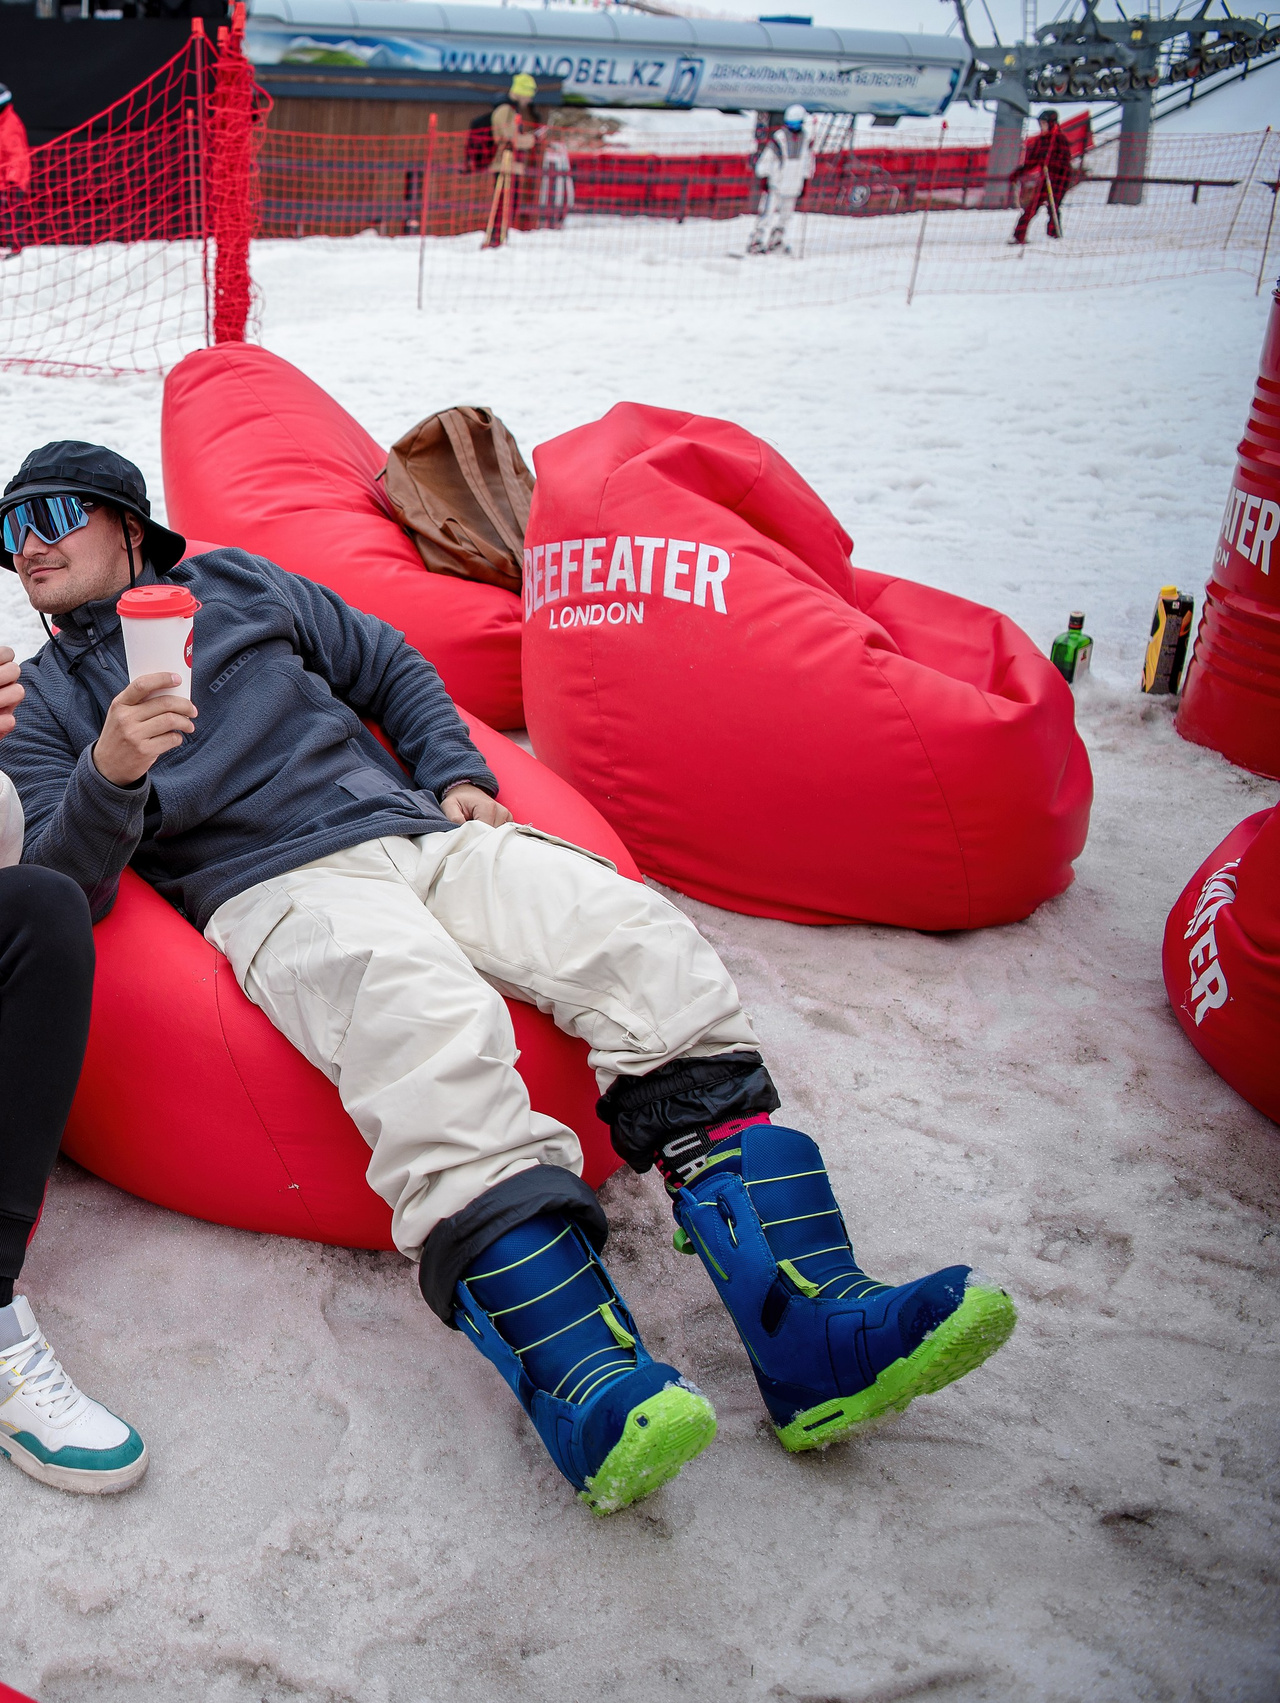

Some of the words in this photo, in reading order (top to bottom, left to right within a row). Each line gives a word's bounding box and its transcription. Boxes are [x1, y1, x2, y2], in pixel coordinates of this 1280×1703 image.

[440, 51, 666, 87] WWWNOBEL.KZ
[523, 535, 731, 624] BEEFEATER
[549, 601, 644, 630] LONDON
[210, 648, 257, 691] BURTON
